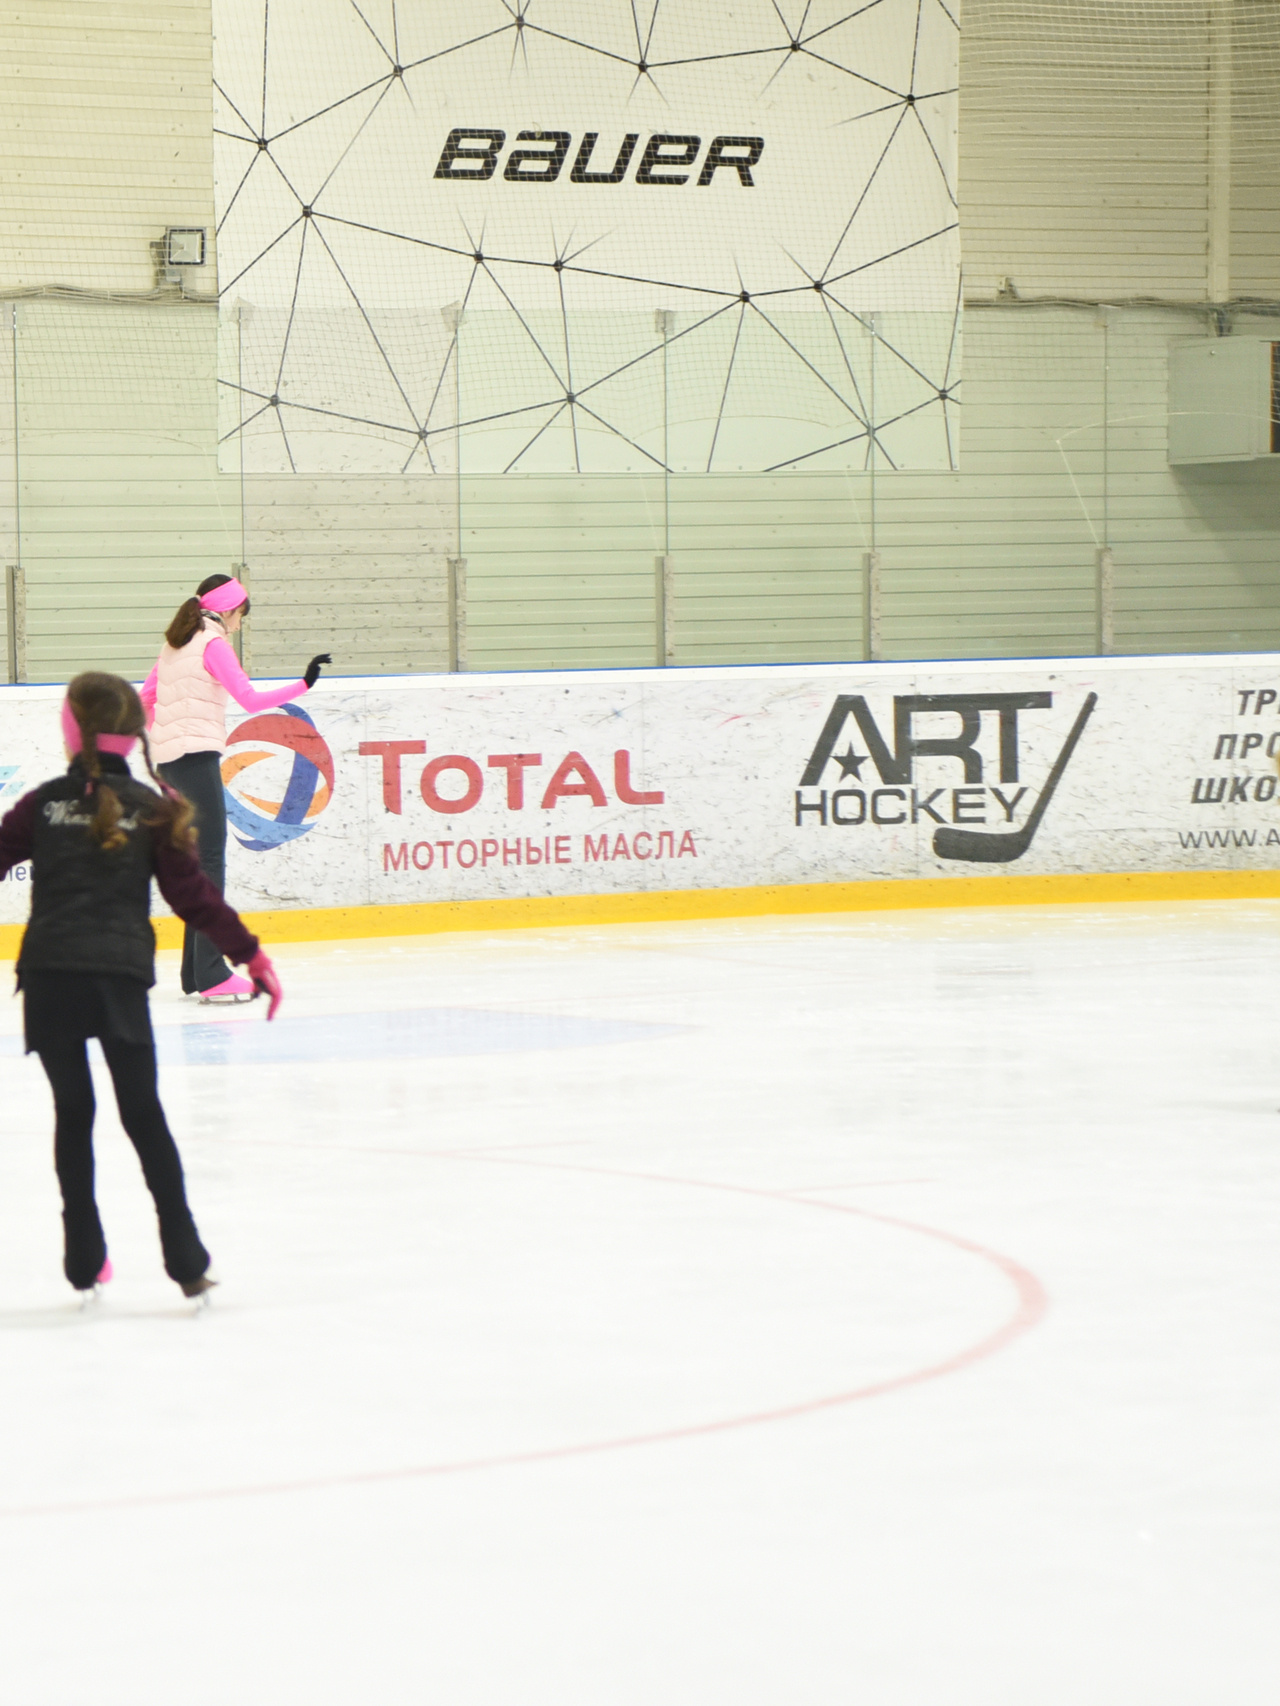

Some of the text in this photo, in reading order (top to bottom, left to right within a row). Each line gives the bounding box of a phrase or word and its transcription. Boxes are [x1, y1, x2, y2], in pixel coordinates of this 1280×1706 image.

[1238, 689, 1280, 715] ТР
[798, 691, 1052, 786] ART
[358, 740, 665, 815] TOTAL
[795, 786, 1029, 827] HOCKEY
[383, 829, 698, 872] МОТОРНЫЕ МАСЛА
